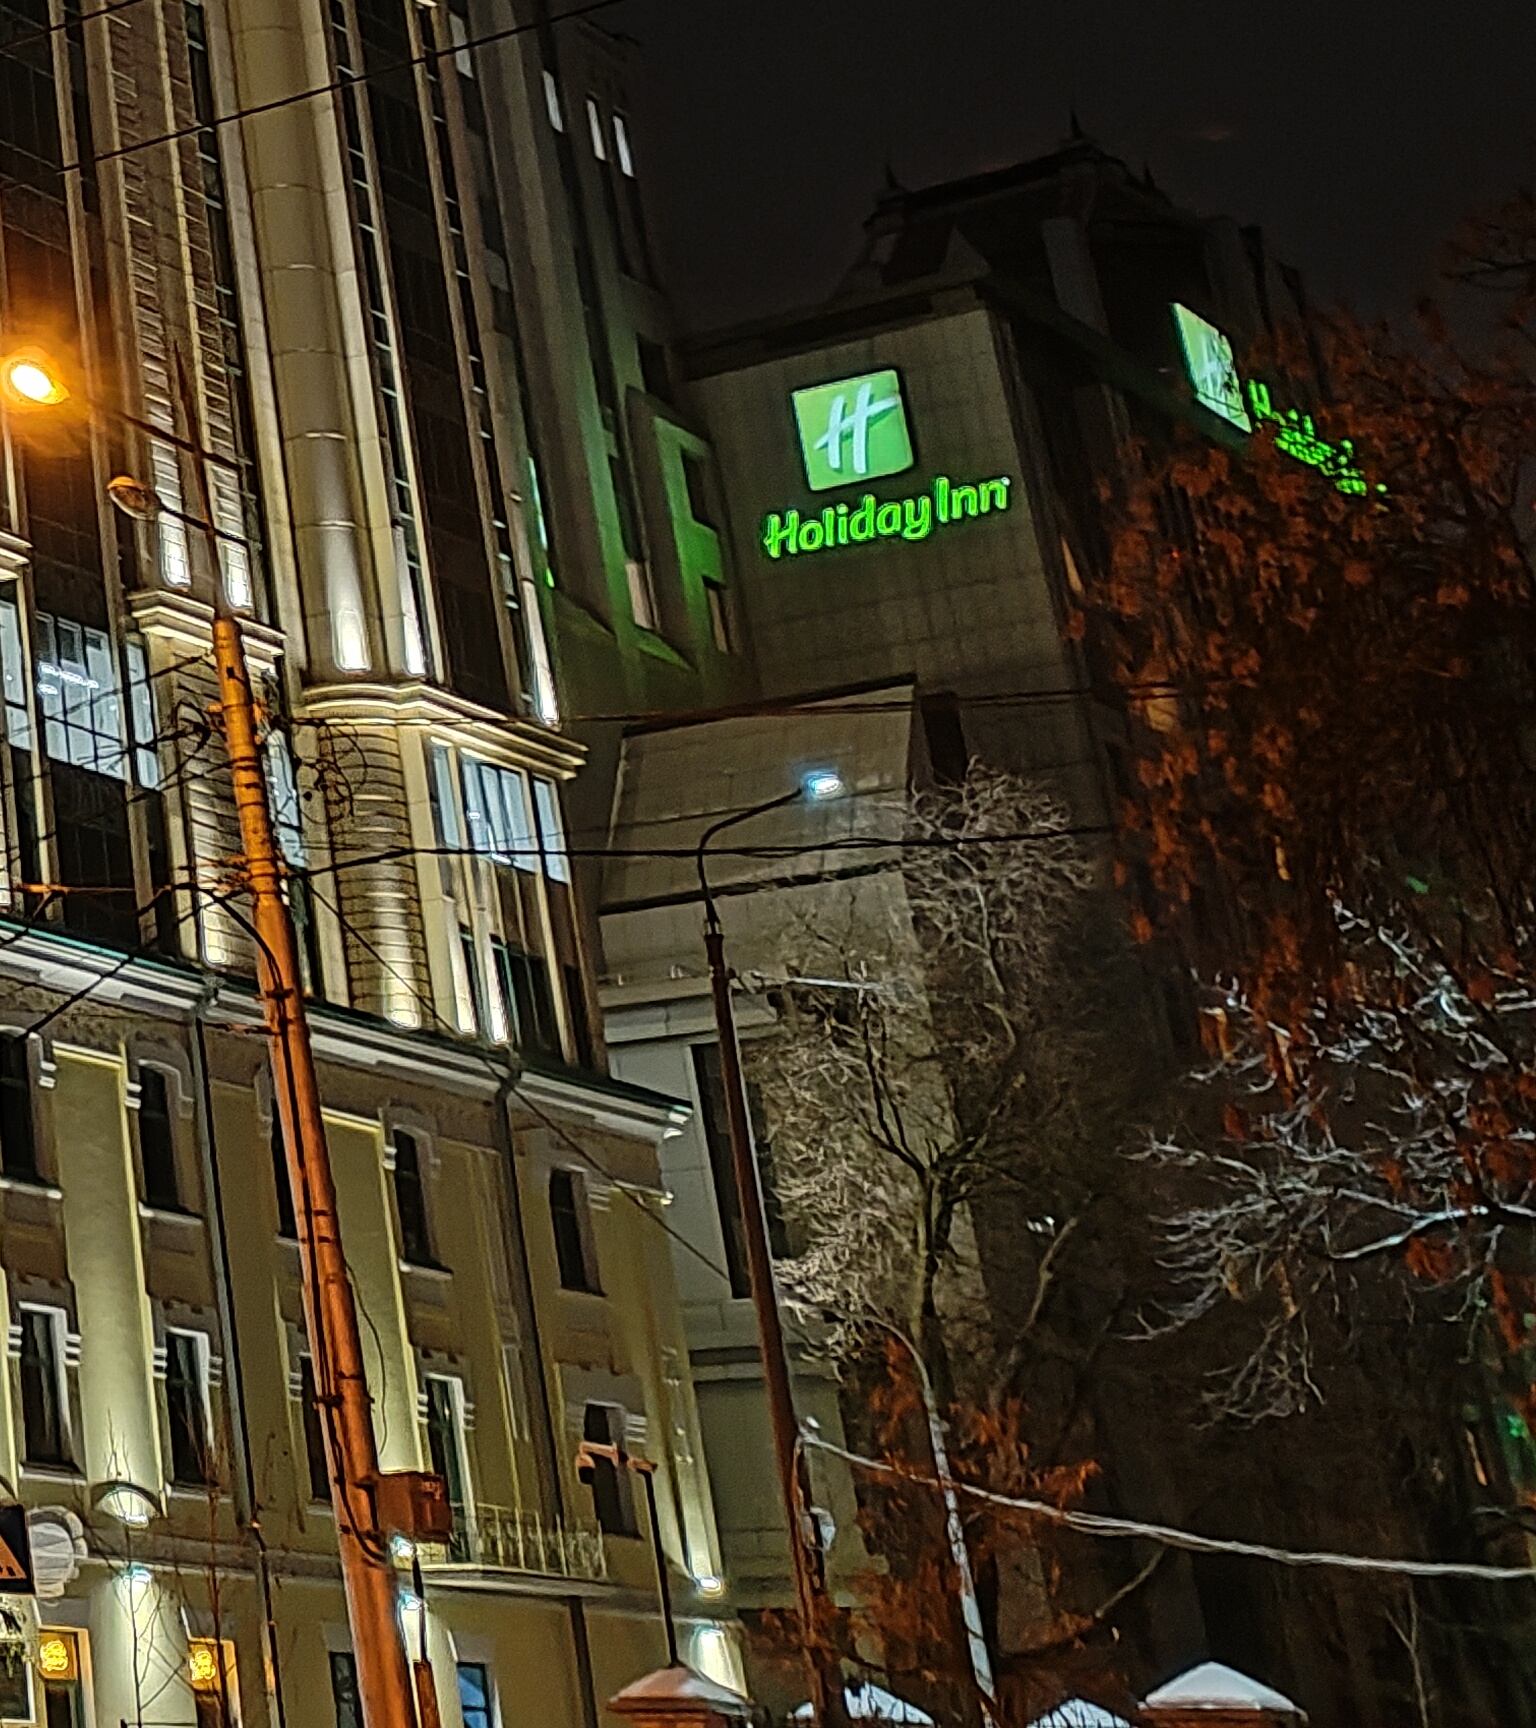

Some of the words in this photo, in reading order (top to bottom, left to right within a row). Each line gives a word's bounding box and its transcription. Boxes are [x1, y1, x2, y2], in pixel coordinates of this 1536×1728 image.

[814, 383, 899, 474] H
[764, 494, 931, 559] Holiday
[936, 477, 1007, 523] Inn
